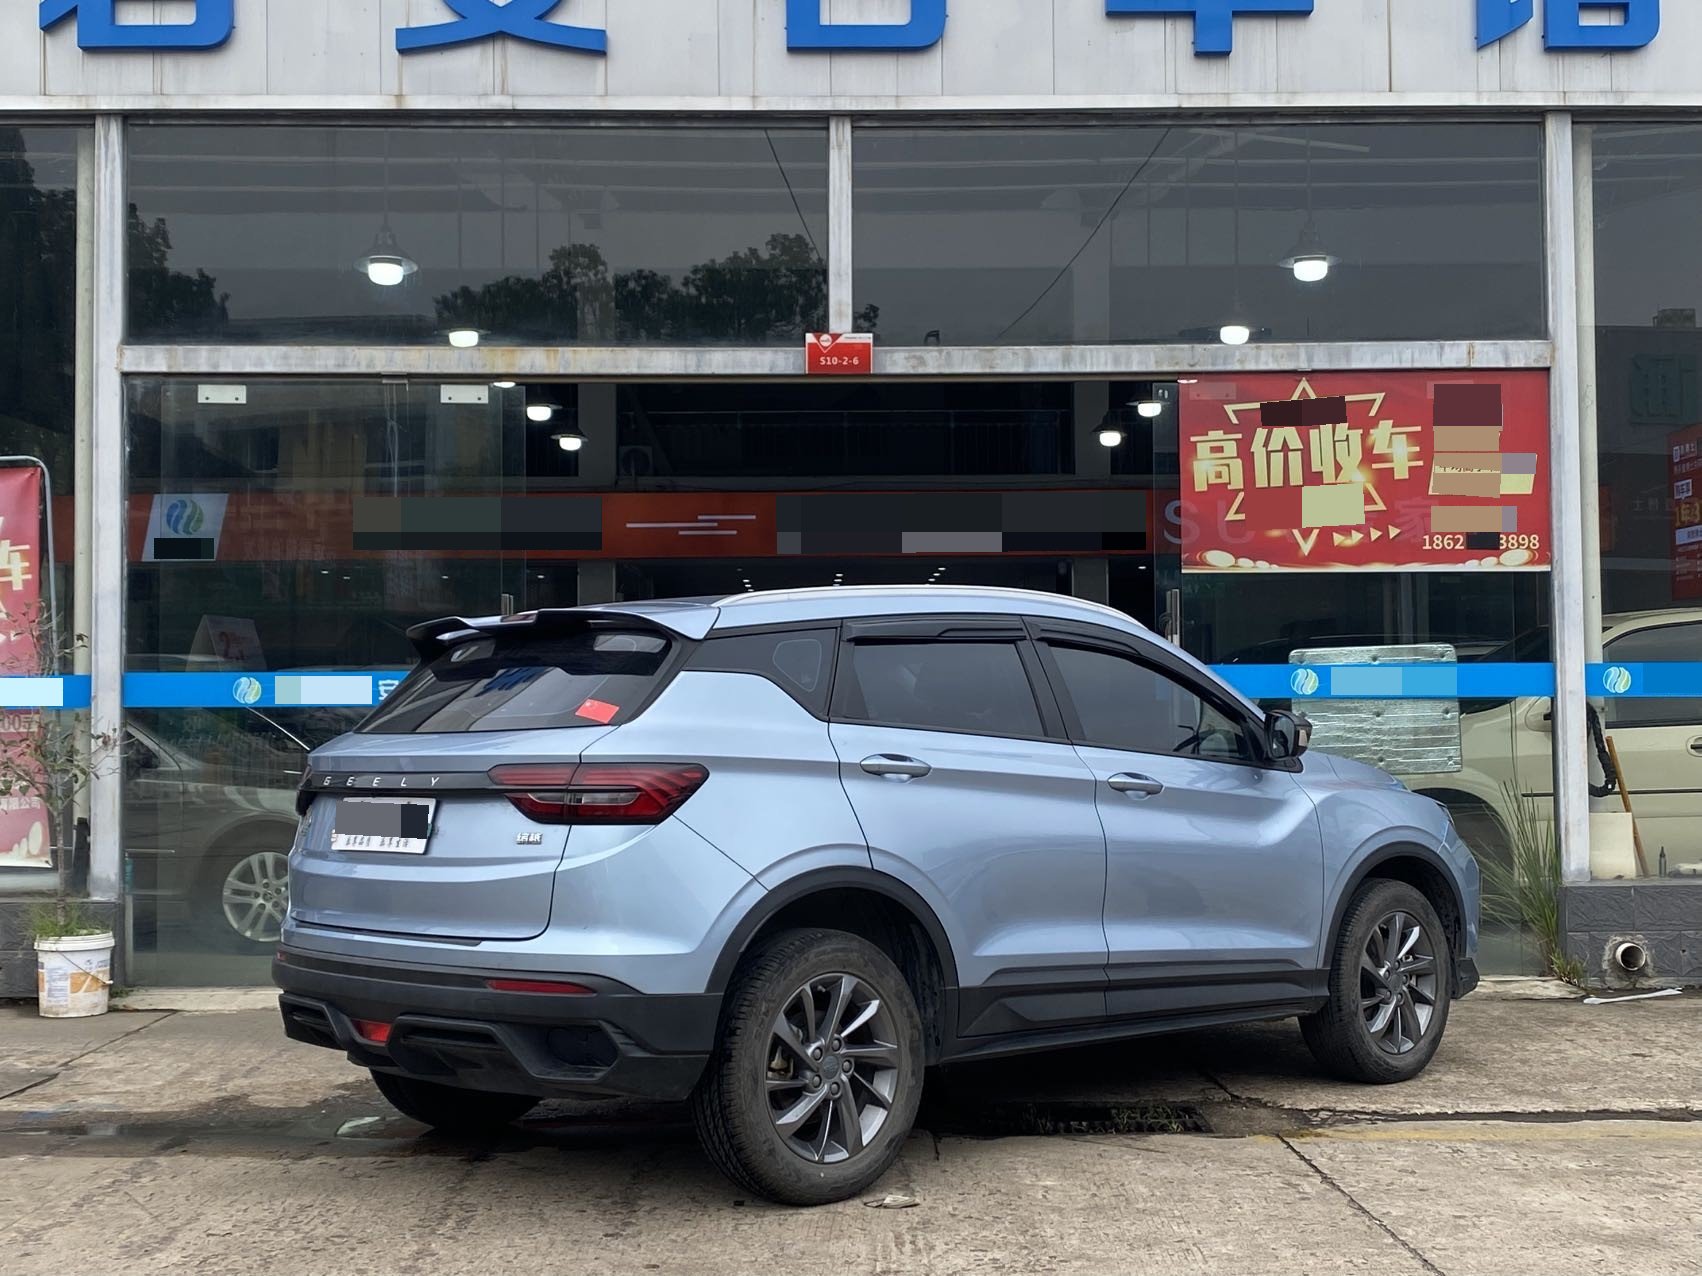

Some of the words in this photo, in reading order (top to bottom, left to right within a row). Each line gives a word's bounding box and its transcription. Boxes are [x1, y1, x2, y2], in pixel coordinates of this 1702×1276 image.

[819, 356, 859, 365] S10-2-6
[1189, 419, 1424, 492] 高价收车
[1422, 534, 1540, 550] 18623898
[322, 776, 440, 787] GEELY
